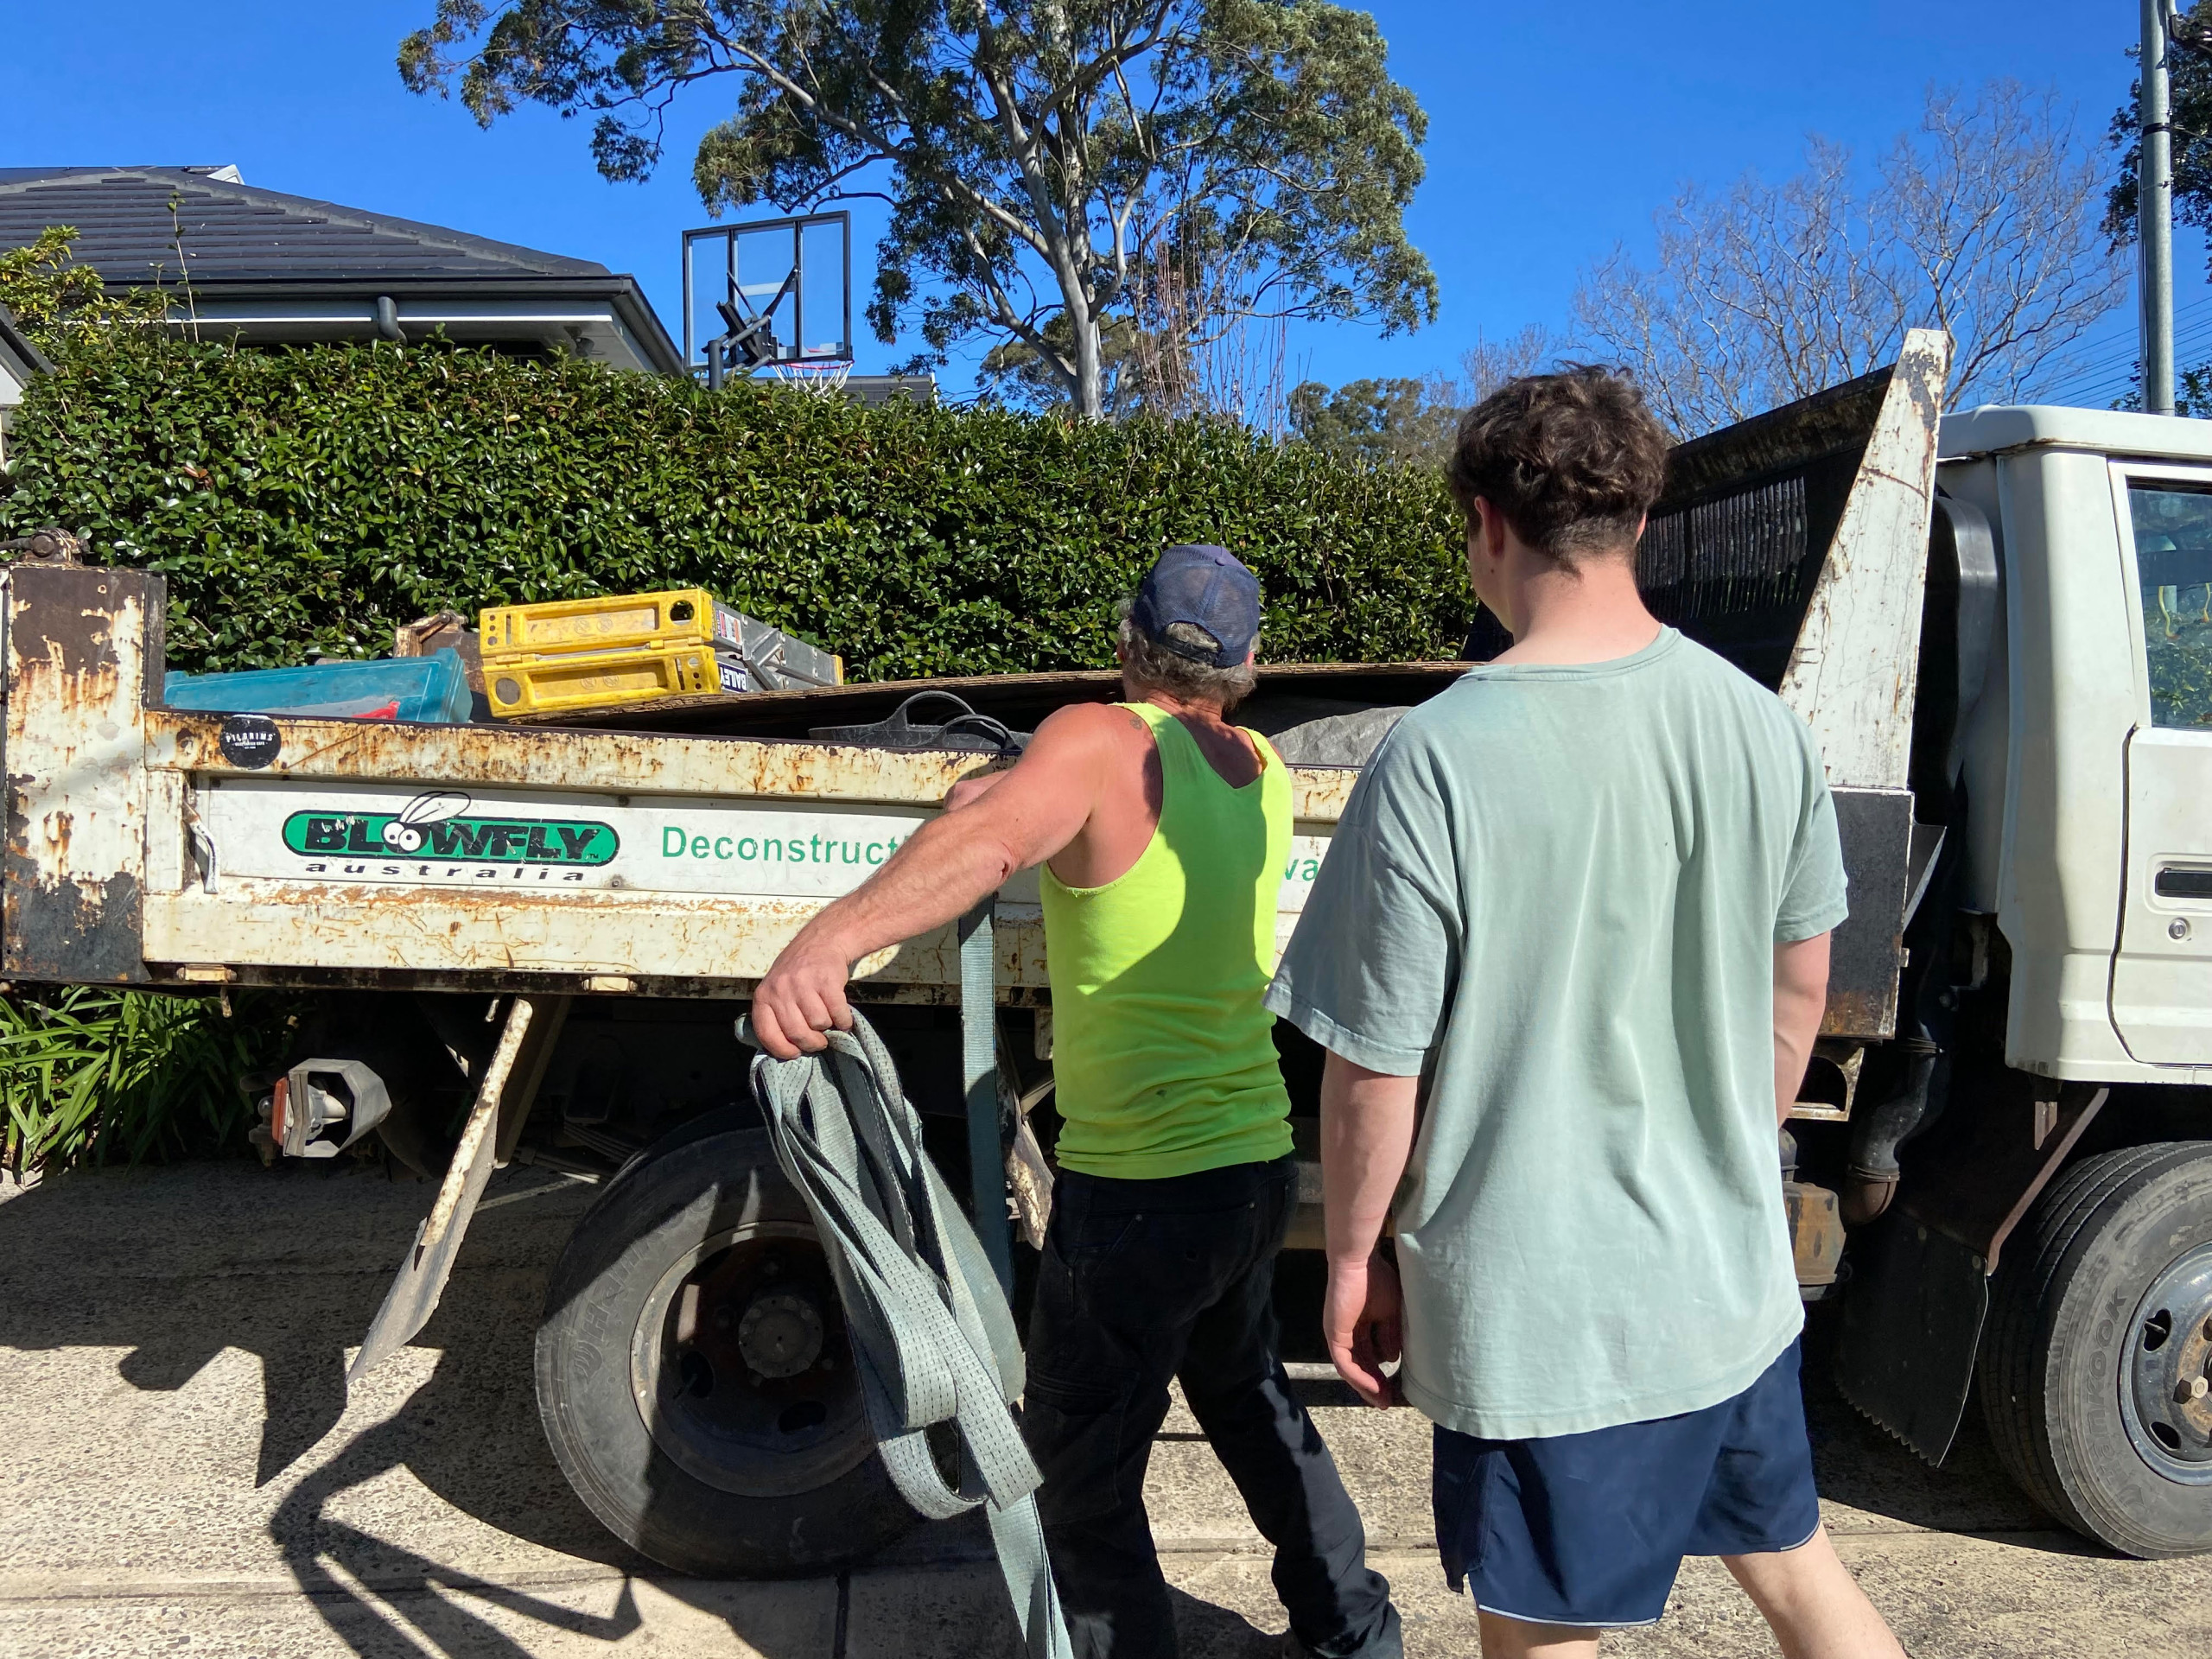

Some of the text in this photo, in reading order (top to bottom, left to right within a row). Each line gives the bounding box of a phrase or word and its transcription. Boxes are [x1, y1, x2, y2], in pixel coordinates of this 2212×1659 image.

[720, 666, 747, 691] BAILEY
[226, 732, 273, 742] PILGRIMS
[305, 818, 600, 859] BLOWFLY
[662, 826, 911, 865] Deconstruct
[305, 862, 584, 881] australia
